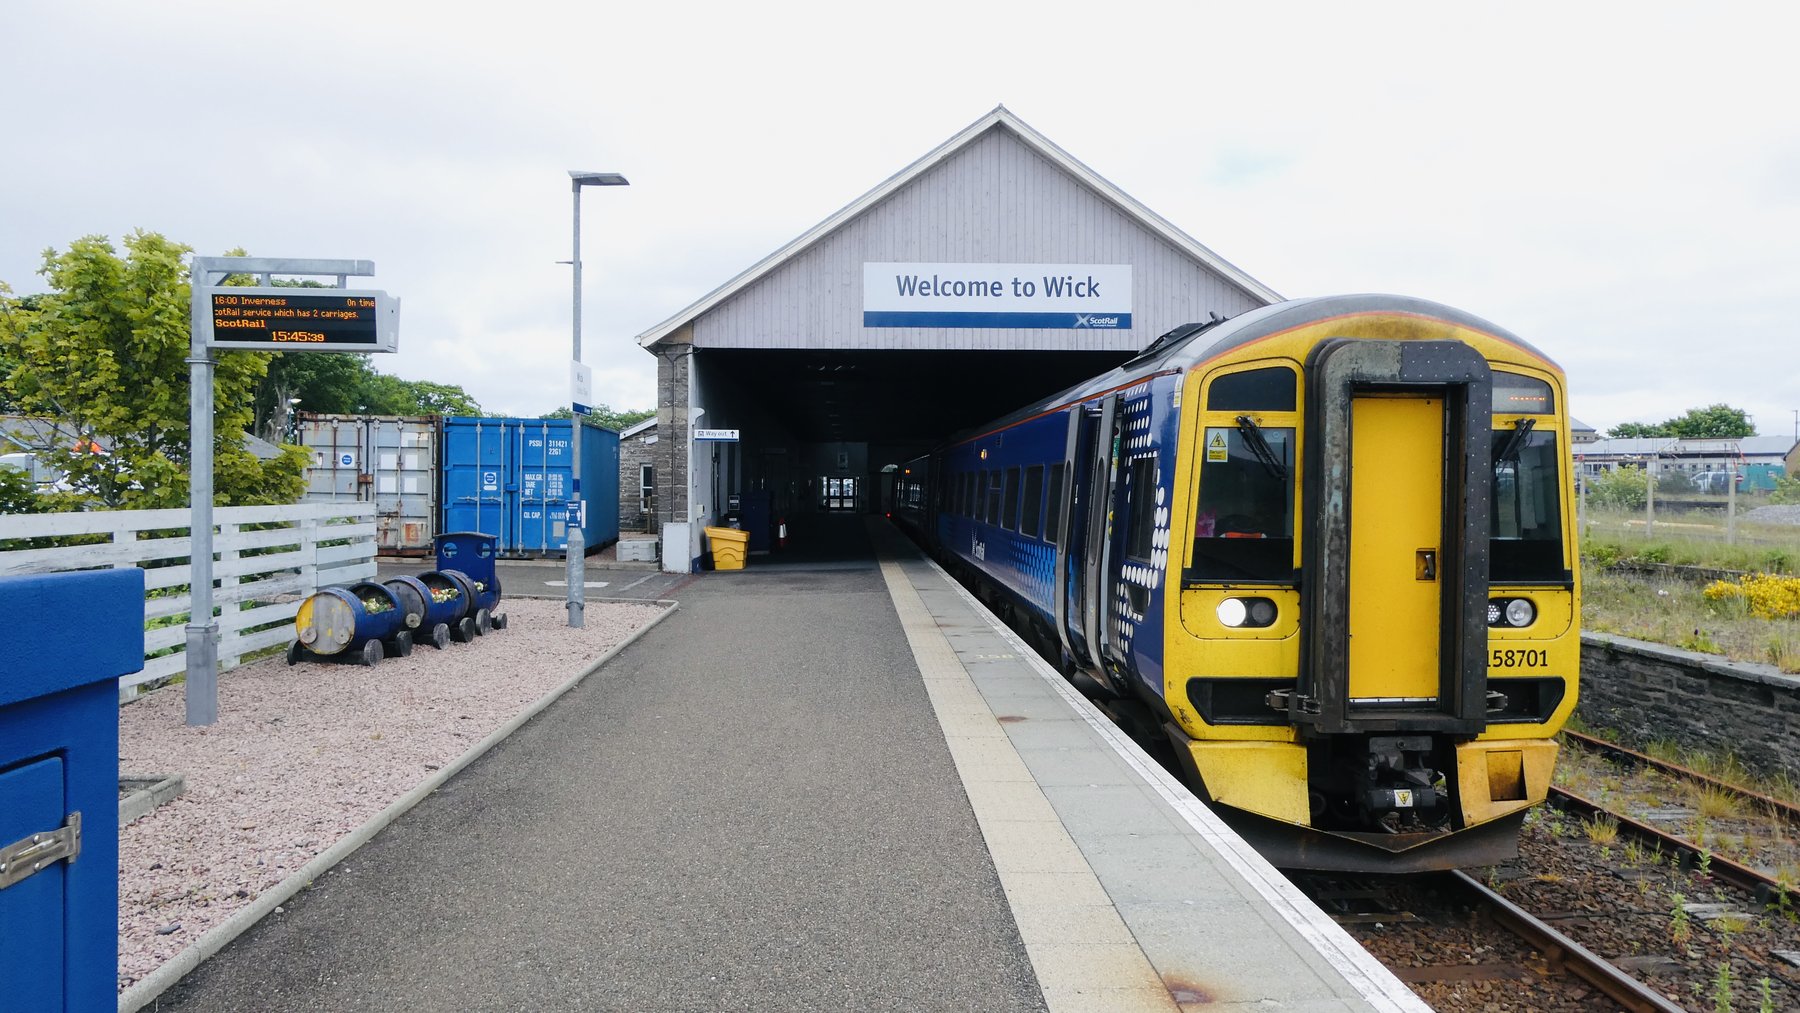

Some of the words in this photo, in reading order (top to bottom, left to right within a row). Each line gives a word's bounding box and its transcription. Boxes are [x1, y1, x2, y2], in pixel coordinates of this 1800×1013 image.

[895, 274, 1003, 297] Welcome
[1011, 277, 1036, 297] to
[1042, 275, 1100, 298] Wick
[214, 296, 238, 305] 16:00
[241, 296, 287, 306] Inverness
[346, 298, 357, 307] On
[359, 298, 375, 307] time
[242, 308, 272, 317] service
[274, 308, 295, 317] which
[297, 309, 311, 318] has
[312, 309, 318, 318] 2
[320, 310, 359, 320] carriages.
[215, 319, 266, 328] ScotRail
[1090, 317, 1118, 325] ScotRail
[271, 331, 325, 342] 15:45:39
[705, 430, 717, 438] Way
[548, 440, 568, 448] 311421
